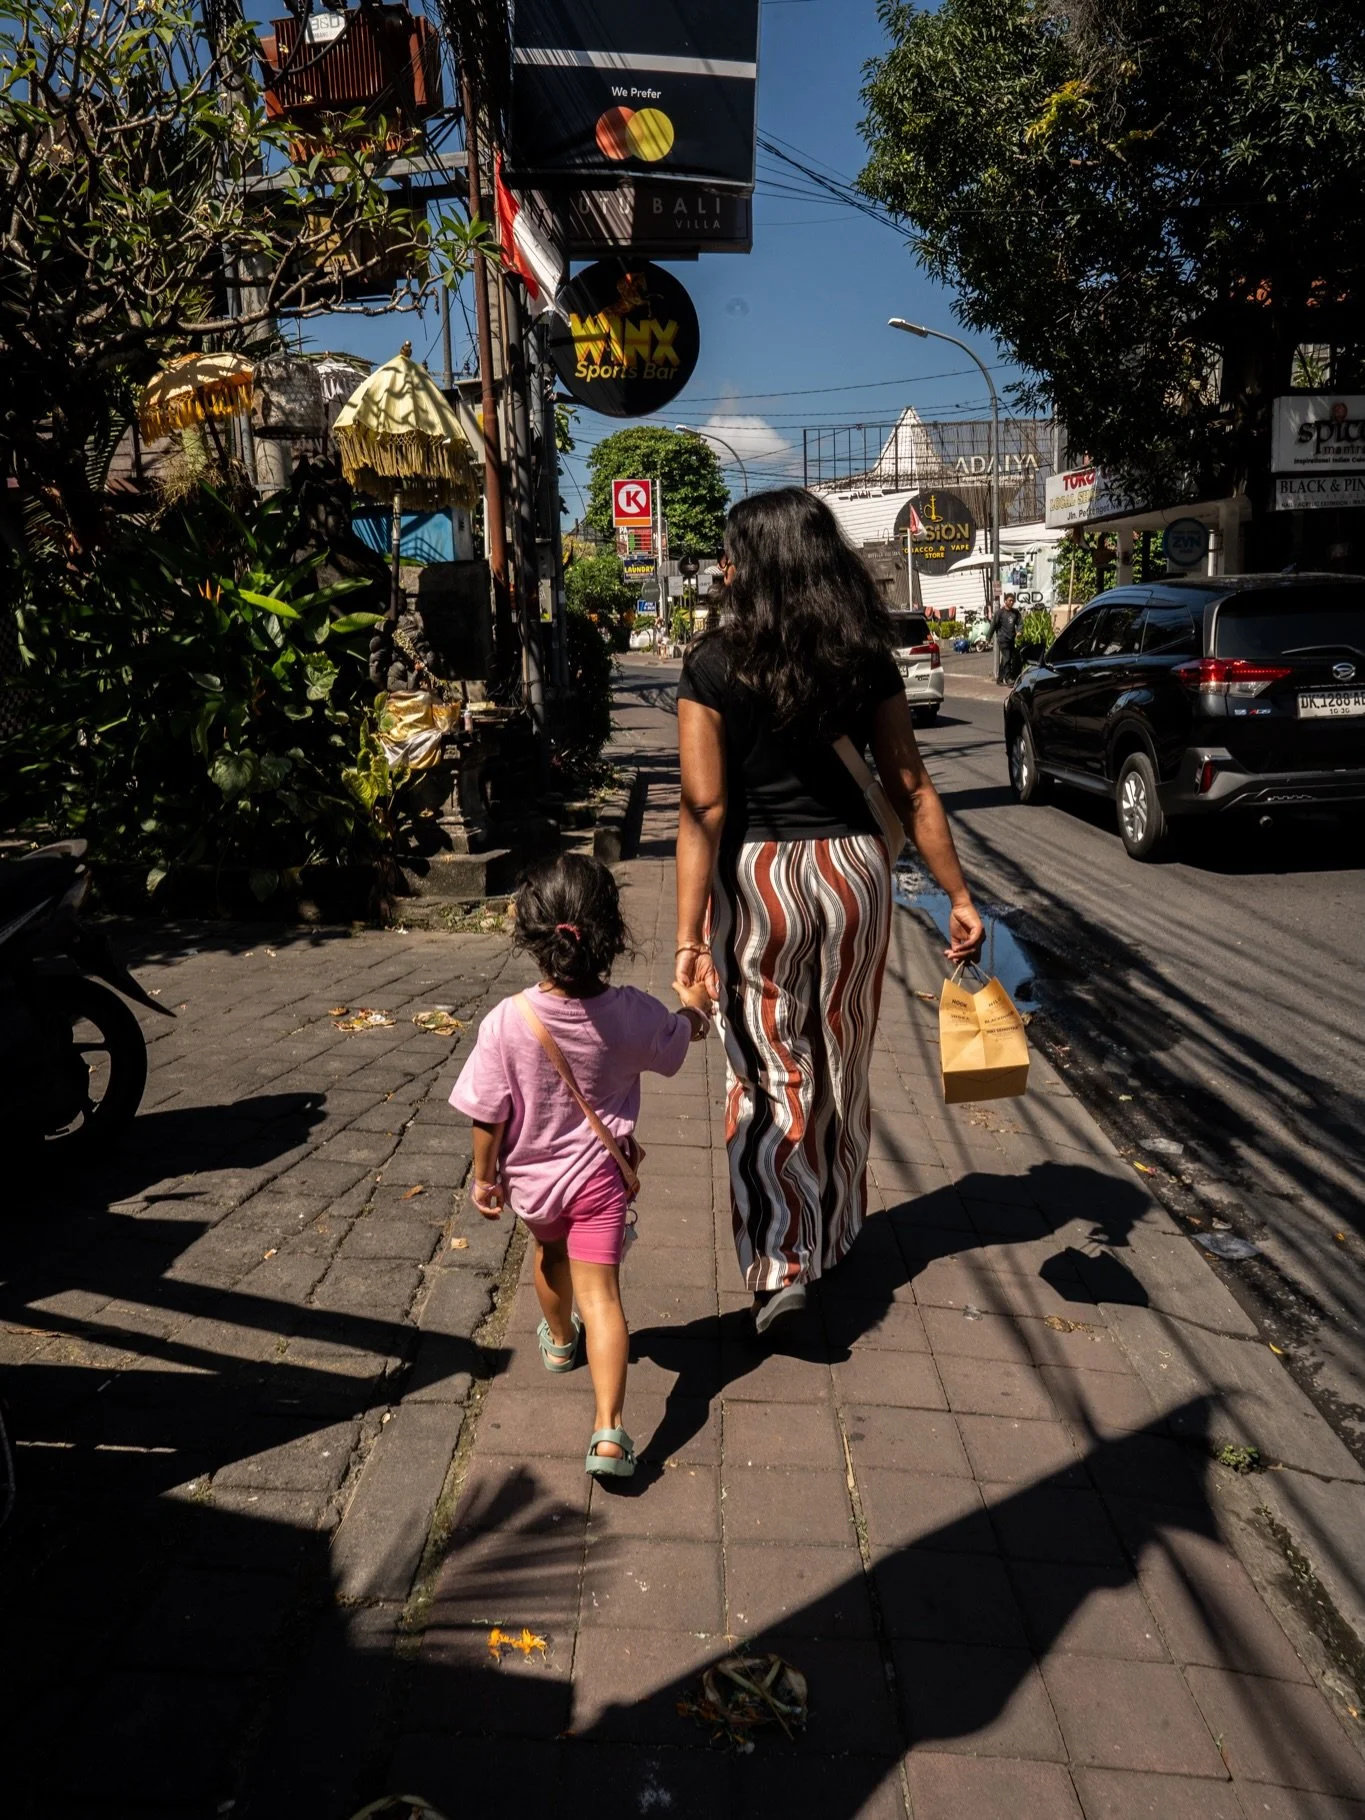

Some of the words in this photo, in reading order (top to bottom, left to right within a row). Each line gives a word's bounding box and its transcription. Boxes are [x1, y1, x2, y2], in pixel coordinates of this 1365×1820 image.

[611, 86, 628, 97] We
[630, 87, 662, 99] Prefer
[652, 197, 721, 214] BALI
[675, 220, 721, 230] VILLA
[569, 312, 682, 368] WINX
[575, 361, 638, 382] Sports
[643, 363, 678, 381] Bar
[1063, 468, 1096, 491] TOKO
[1280, 479, 1326, 494] BLACK
[1330, 480, 1341, 492] &
[899, 523, 970, 543] FSION
[924, 551, 945, 560] STORE
[950, 543, 971, 553] VAPE
[624, 565, 655, 574] LAUNDRY
